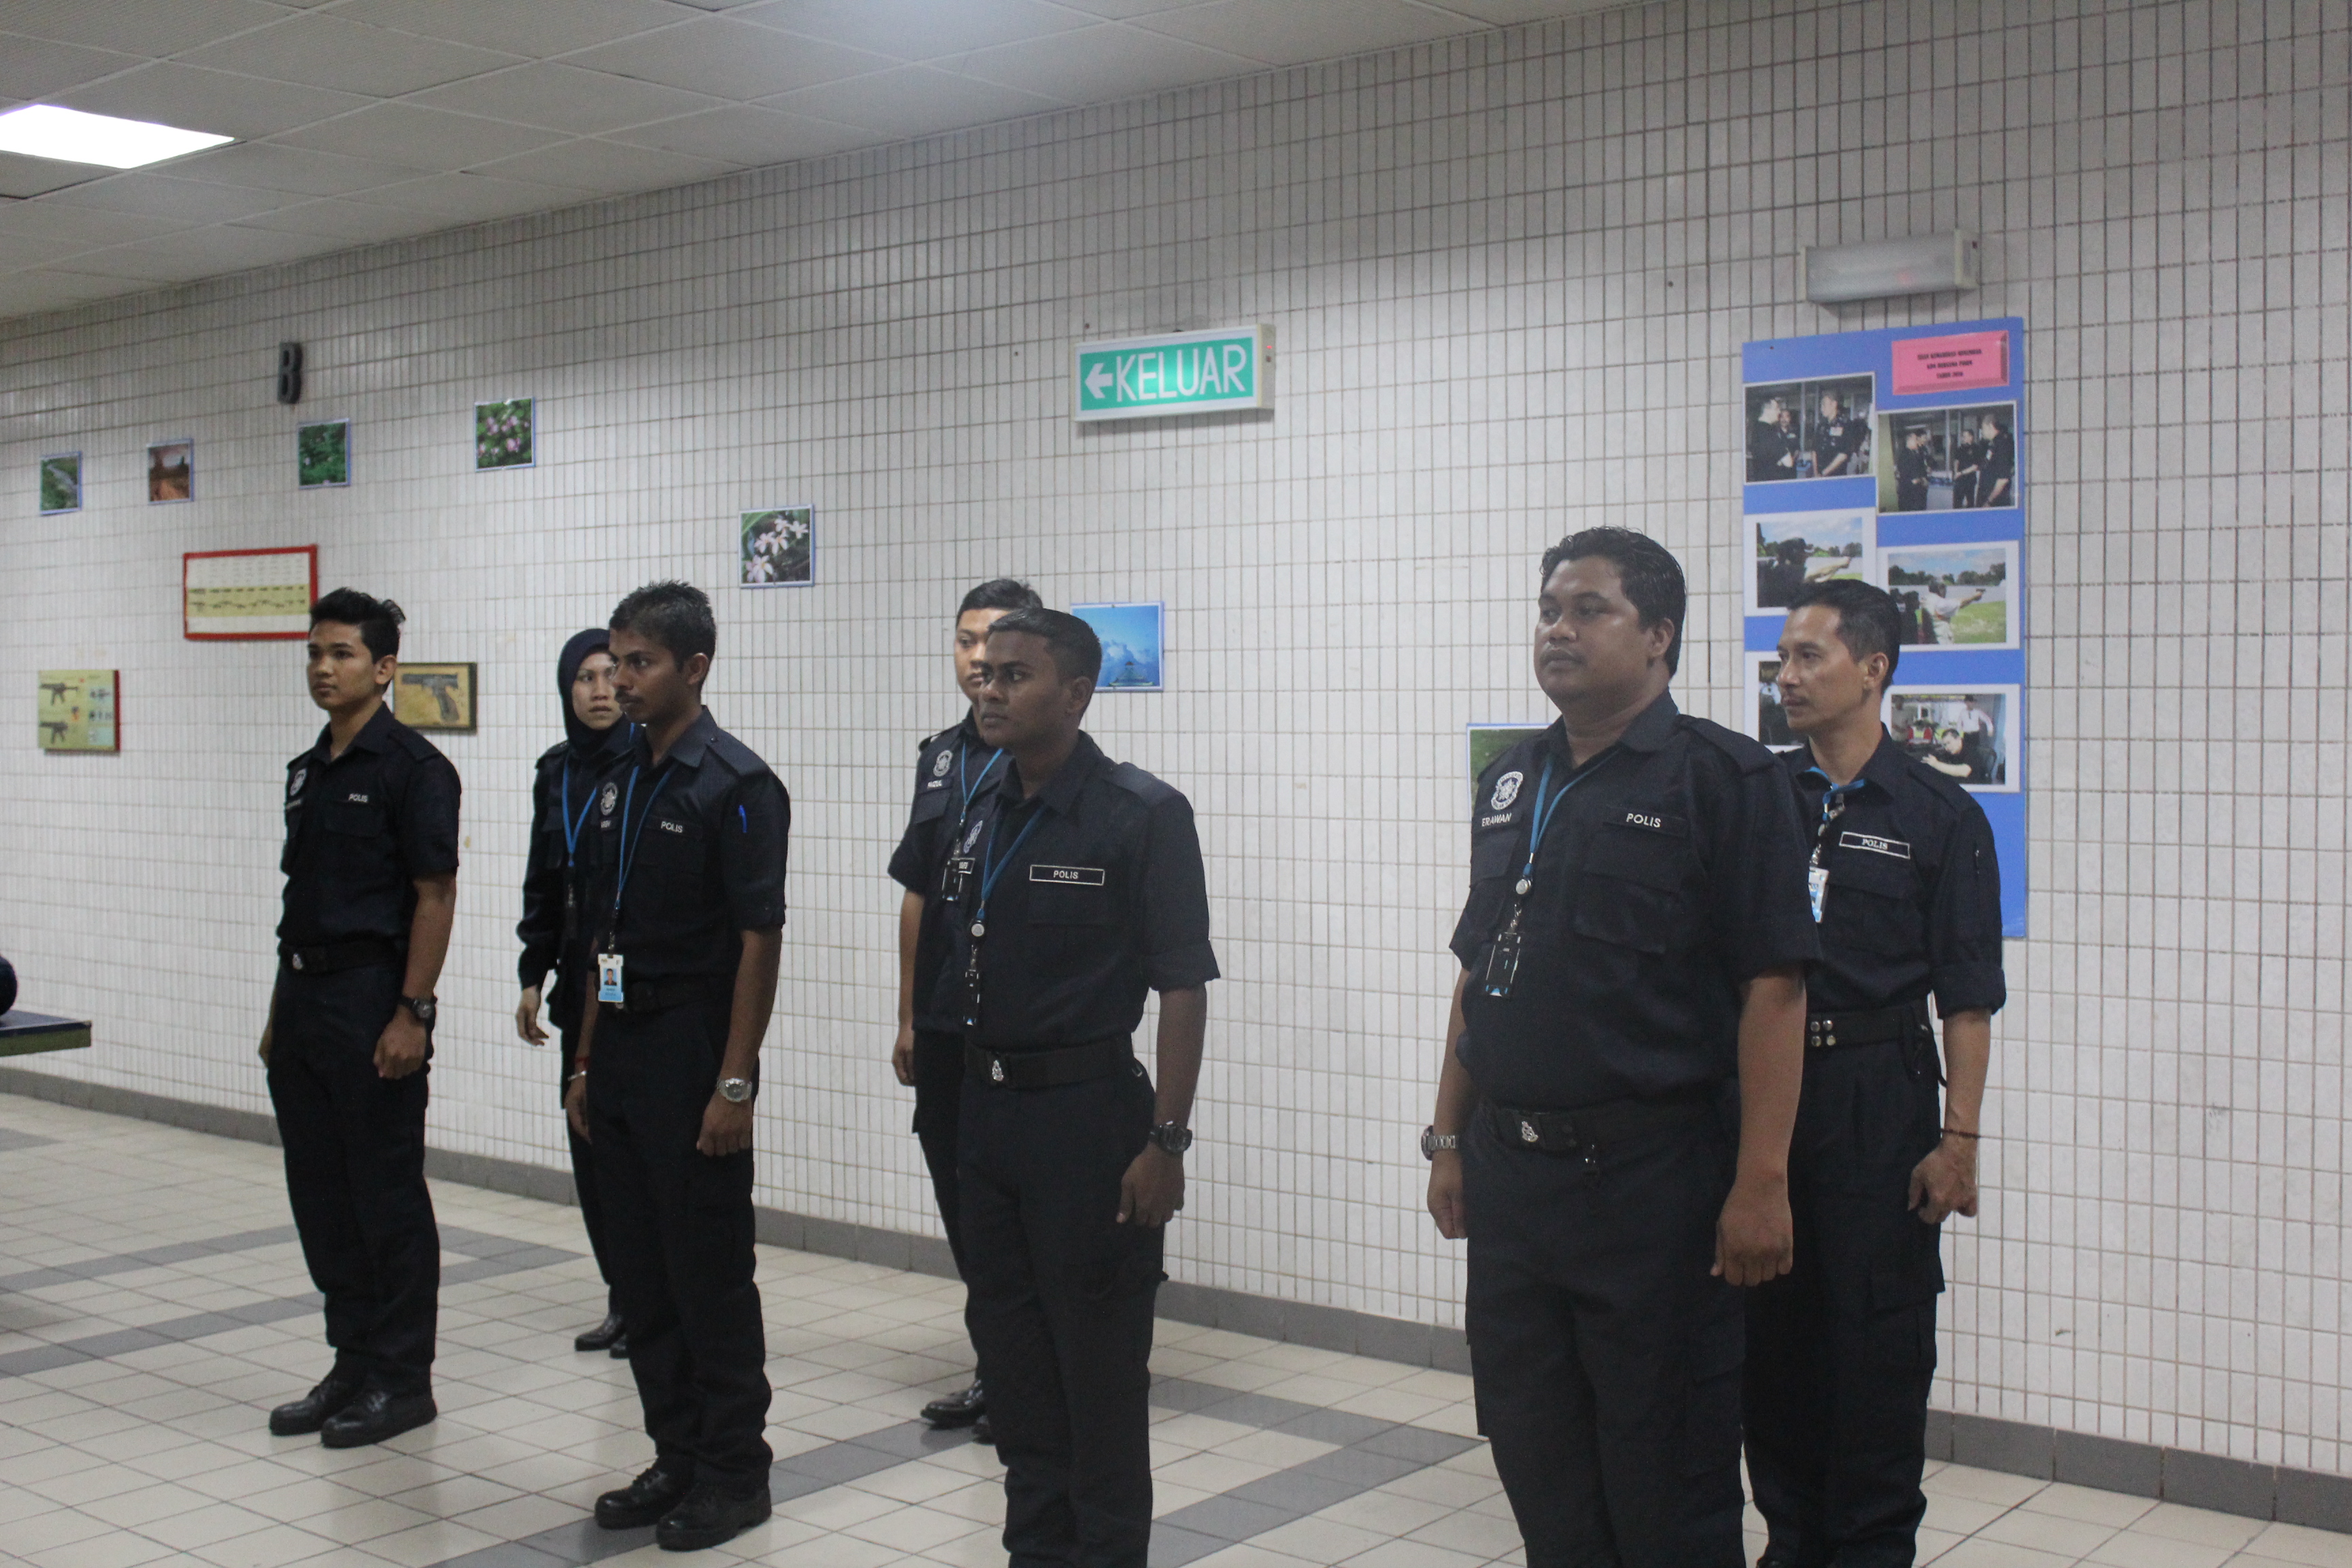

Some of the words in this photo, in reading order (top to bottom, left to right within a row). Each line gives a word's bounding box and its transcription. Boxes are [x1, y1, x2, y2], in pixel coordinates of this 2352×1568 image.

[1116, 344, 1247, 402] KELUAR
[348, 794, 368, 803] POLIS
[1482, 812, 1512, 828] ERAWAN
[1626, 813, 1661, 828] POLIS
[660, 821, 683, 834] POLIS
[1861, 838, 1889, 851] POLIS
[1053, 870, 1079, 880] POLIS
